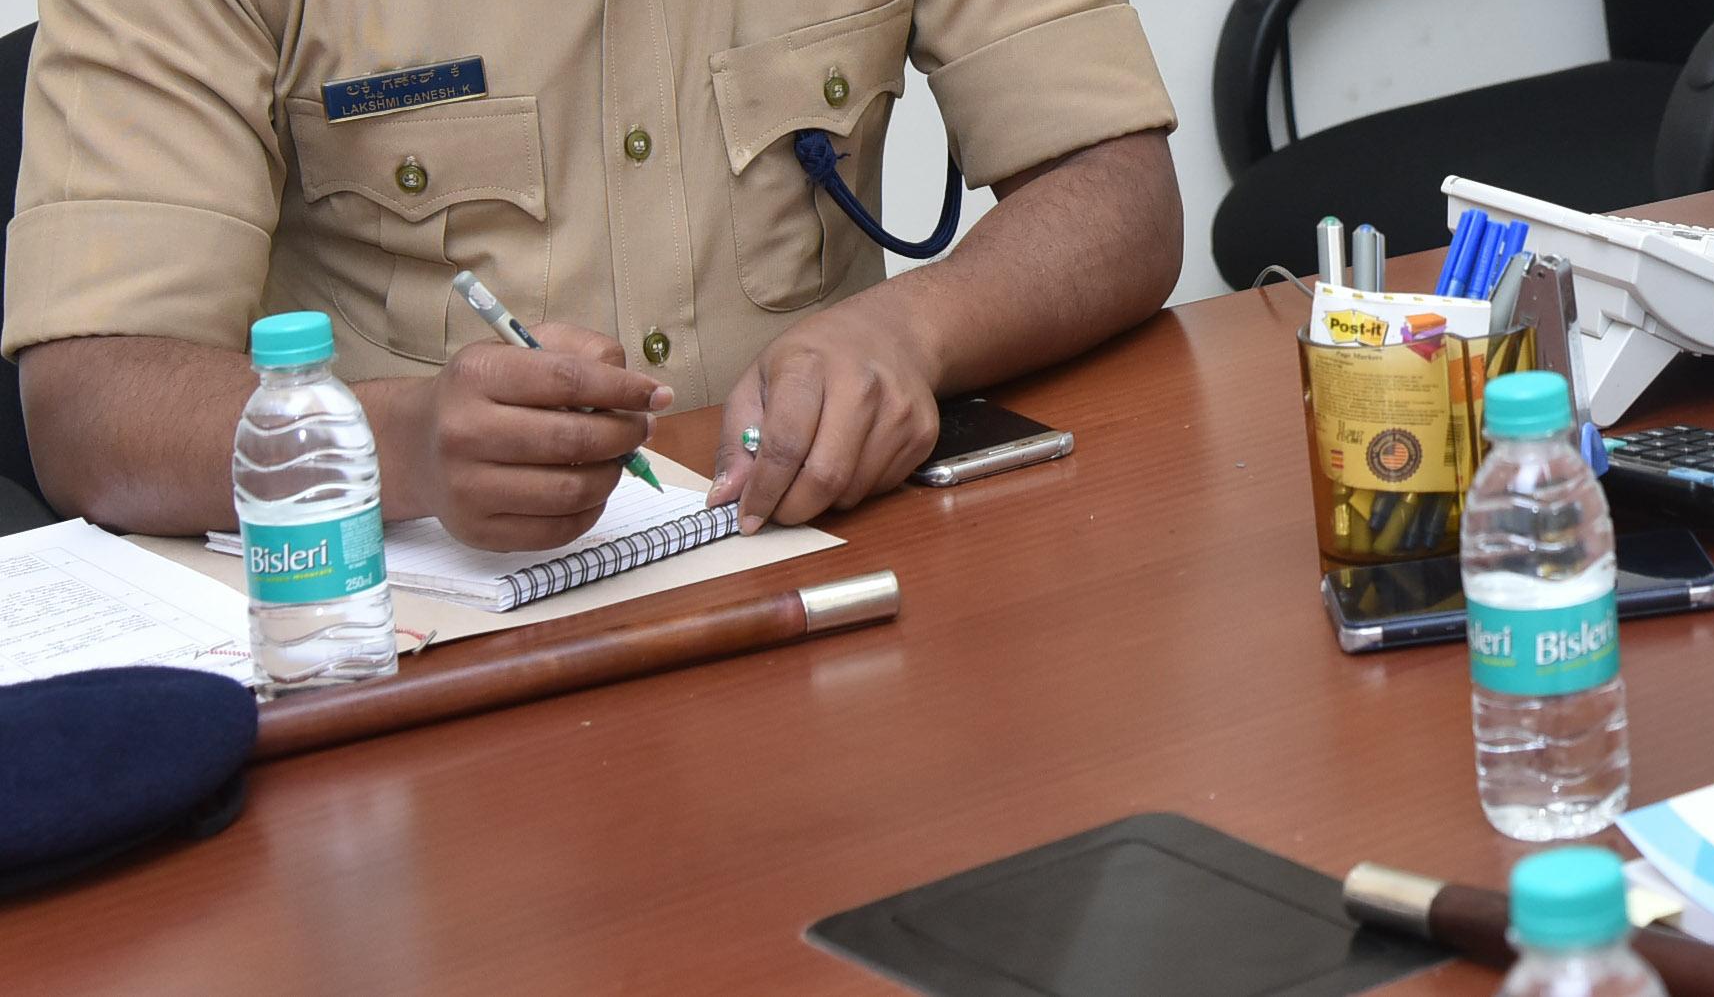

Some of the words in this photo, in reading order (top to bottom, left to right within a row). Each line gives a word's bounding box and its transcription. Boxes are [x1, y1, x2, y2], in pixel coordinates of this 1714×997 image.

[342, 97, 400, 116] LAKSHMI
[462, 83, 472, 94] K
[1329, 317, 1382, 336] Post-it
[250, 539, 329, 574] Bisleri
[1535, 608, 1614, 666] Bisleri
